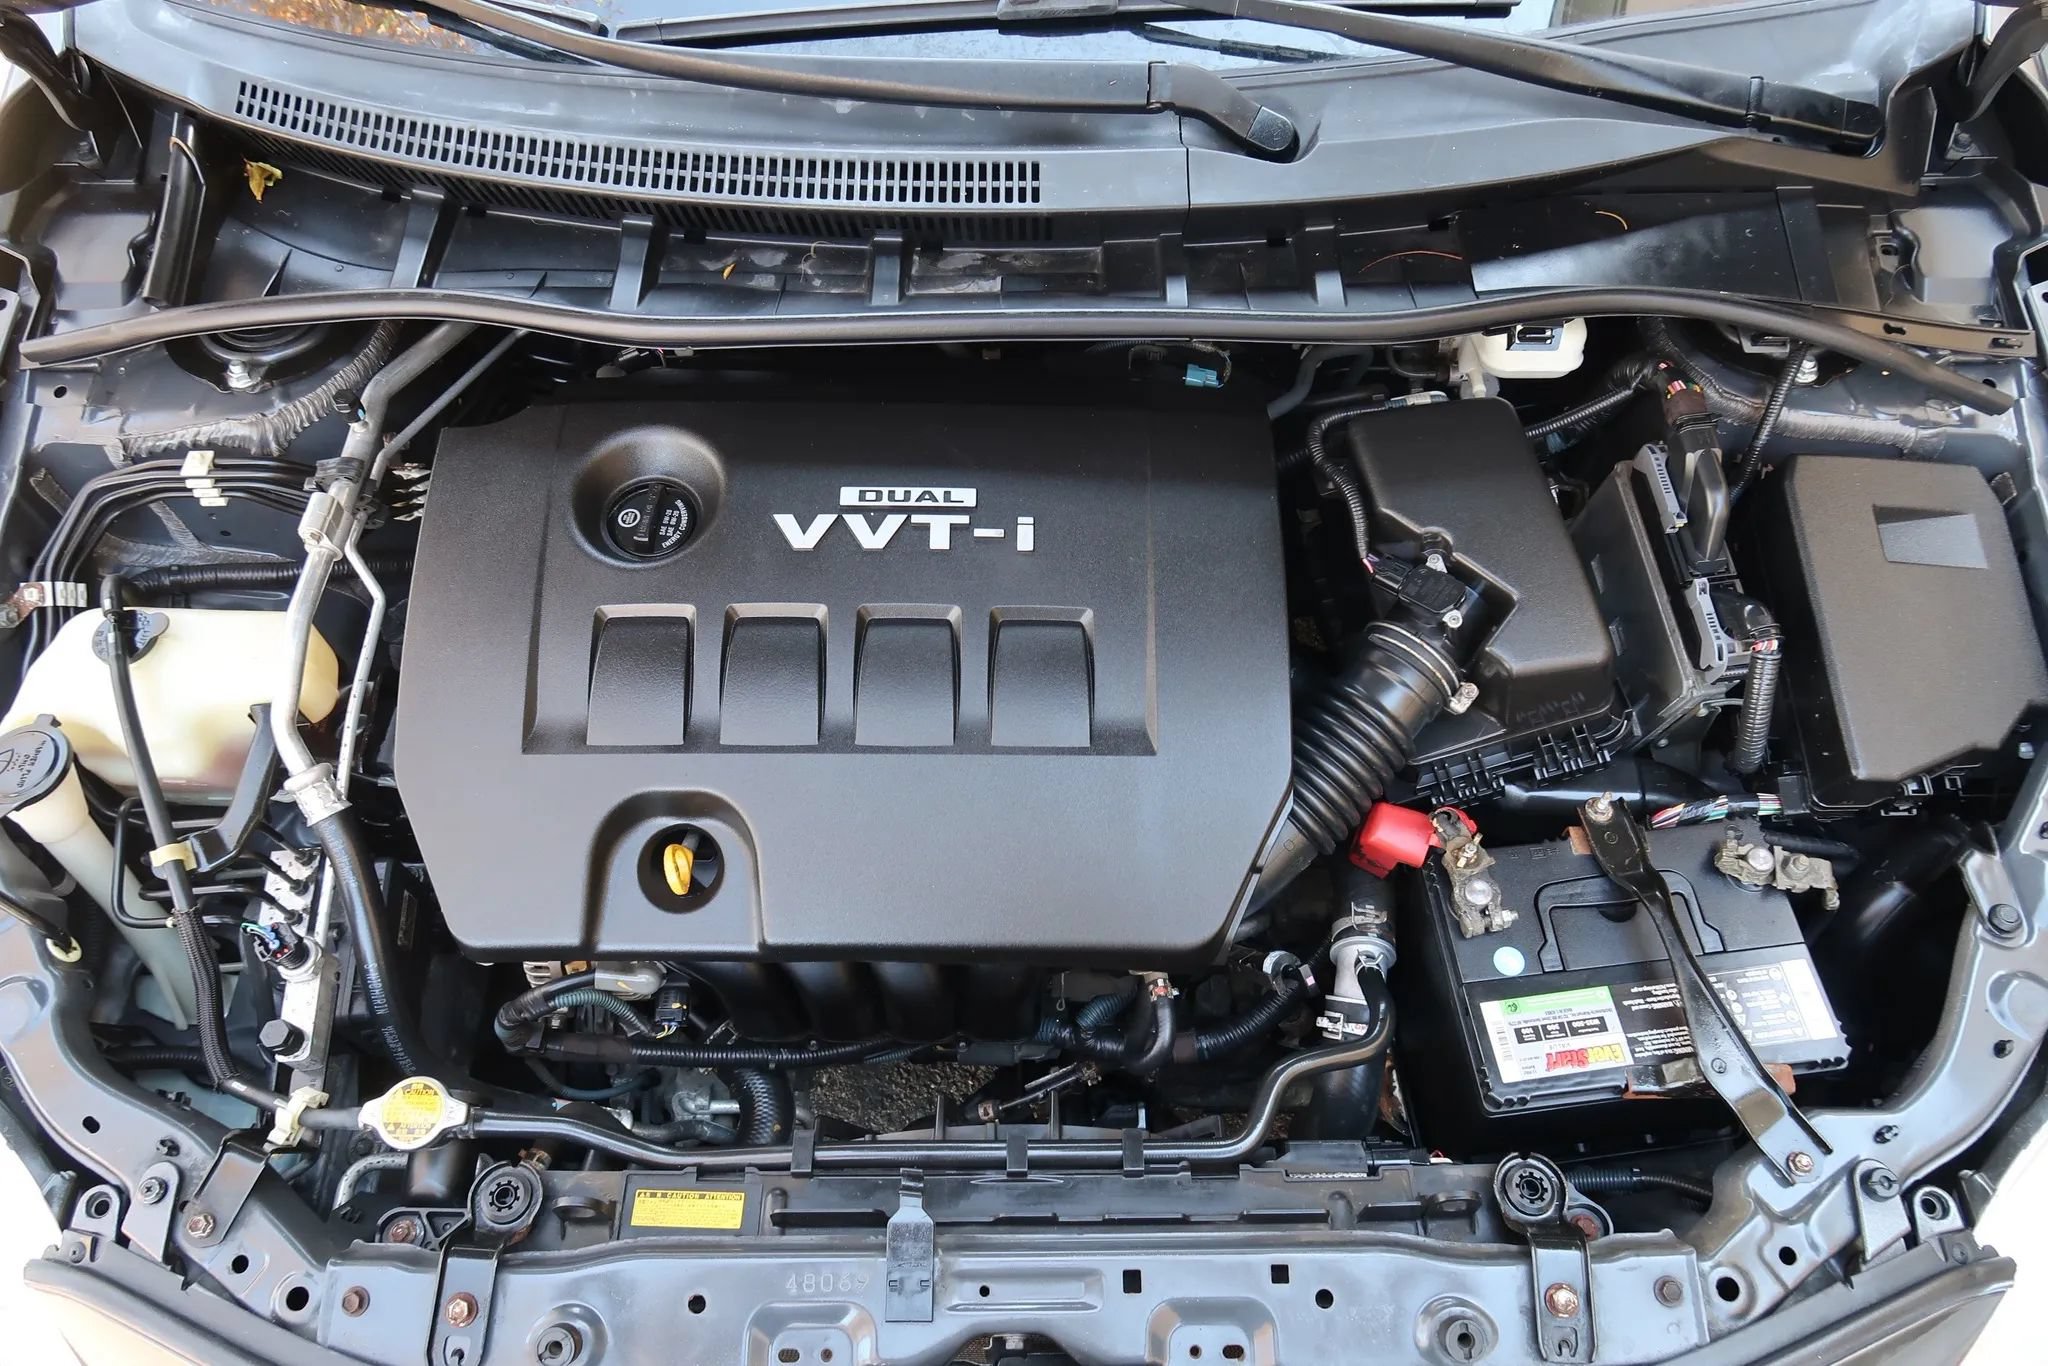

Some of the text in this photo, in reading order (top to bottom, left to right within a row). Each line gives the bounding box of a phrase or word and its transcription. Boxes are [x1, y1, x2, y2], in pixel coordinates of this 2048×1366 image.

[858, 489, 965, 504] DUAL
[659, 525, 667, 536] SAE
[661, 499, 688, 549] ENERGY CONSERVING
[666, 526, 675, 537] SAE
[773, 513, 1035, 551] VVT-i
[1546, 1044, 1624, 1071] EverStart
[404, 1087, 434, 1096] CAUTION
